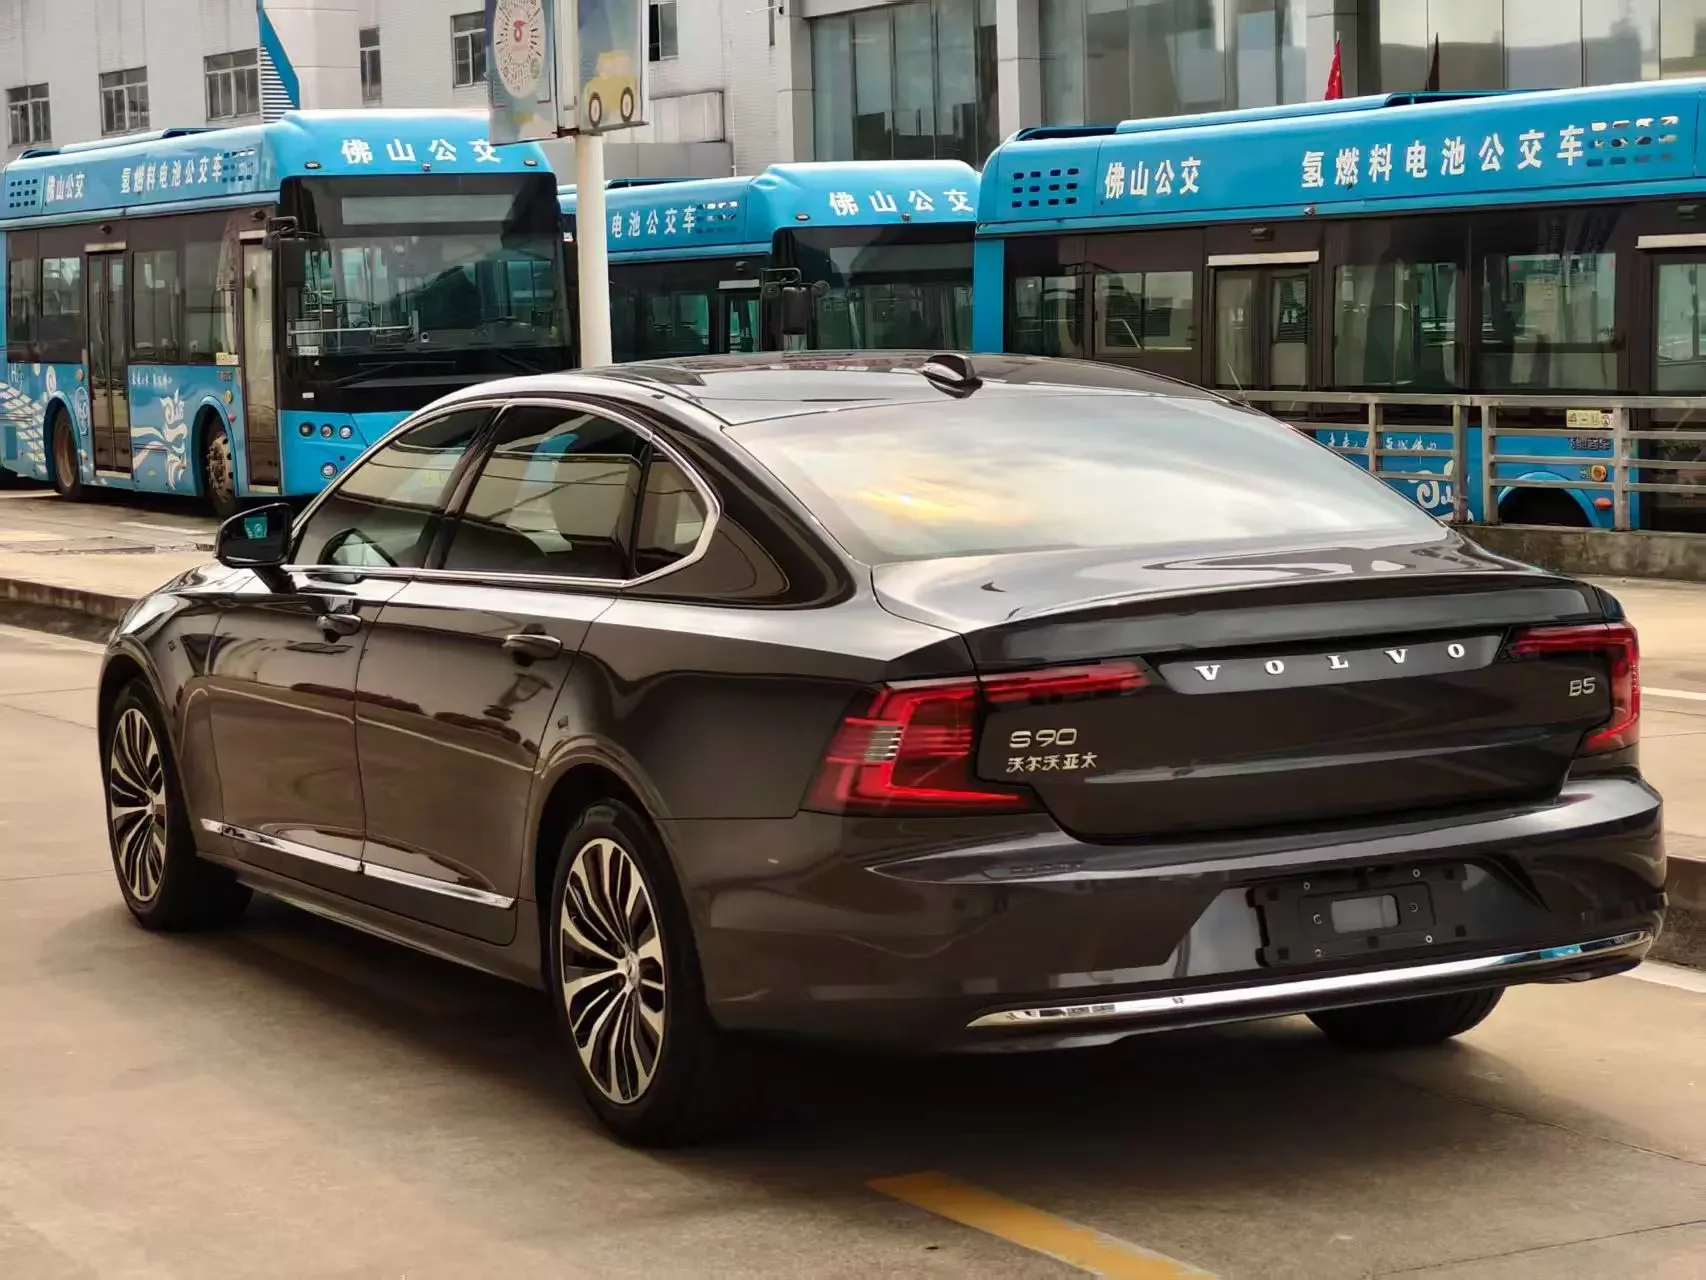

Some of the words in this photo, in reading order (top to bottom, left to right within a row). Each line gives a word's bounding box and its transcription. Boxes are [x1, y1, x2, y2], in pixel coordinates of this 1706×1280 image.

[340, 138, 502, 165] 佛山公交
[1301, 124, 1585, 189] 氢燃料电池公交车
[47, 171, 86, 203] 佛山公交
[120, 153, 224, 194] 氢燃料电池公交车
[1104, 156, 1201, 199] 佛山公交
[829, 189, 974, 217] 佛山公交
[611, 205, 697, 239] 电池公交车
[1194, 643, 1466, 682] VOLVO
[1568, 677, 1597, 697] B5
[1009, 728, 1077, 748] S90
[1006, 752, 1098, 773] 沃尔沃亚太
